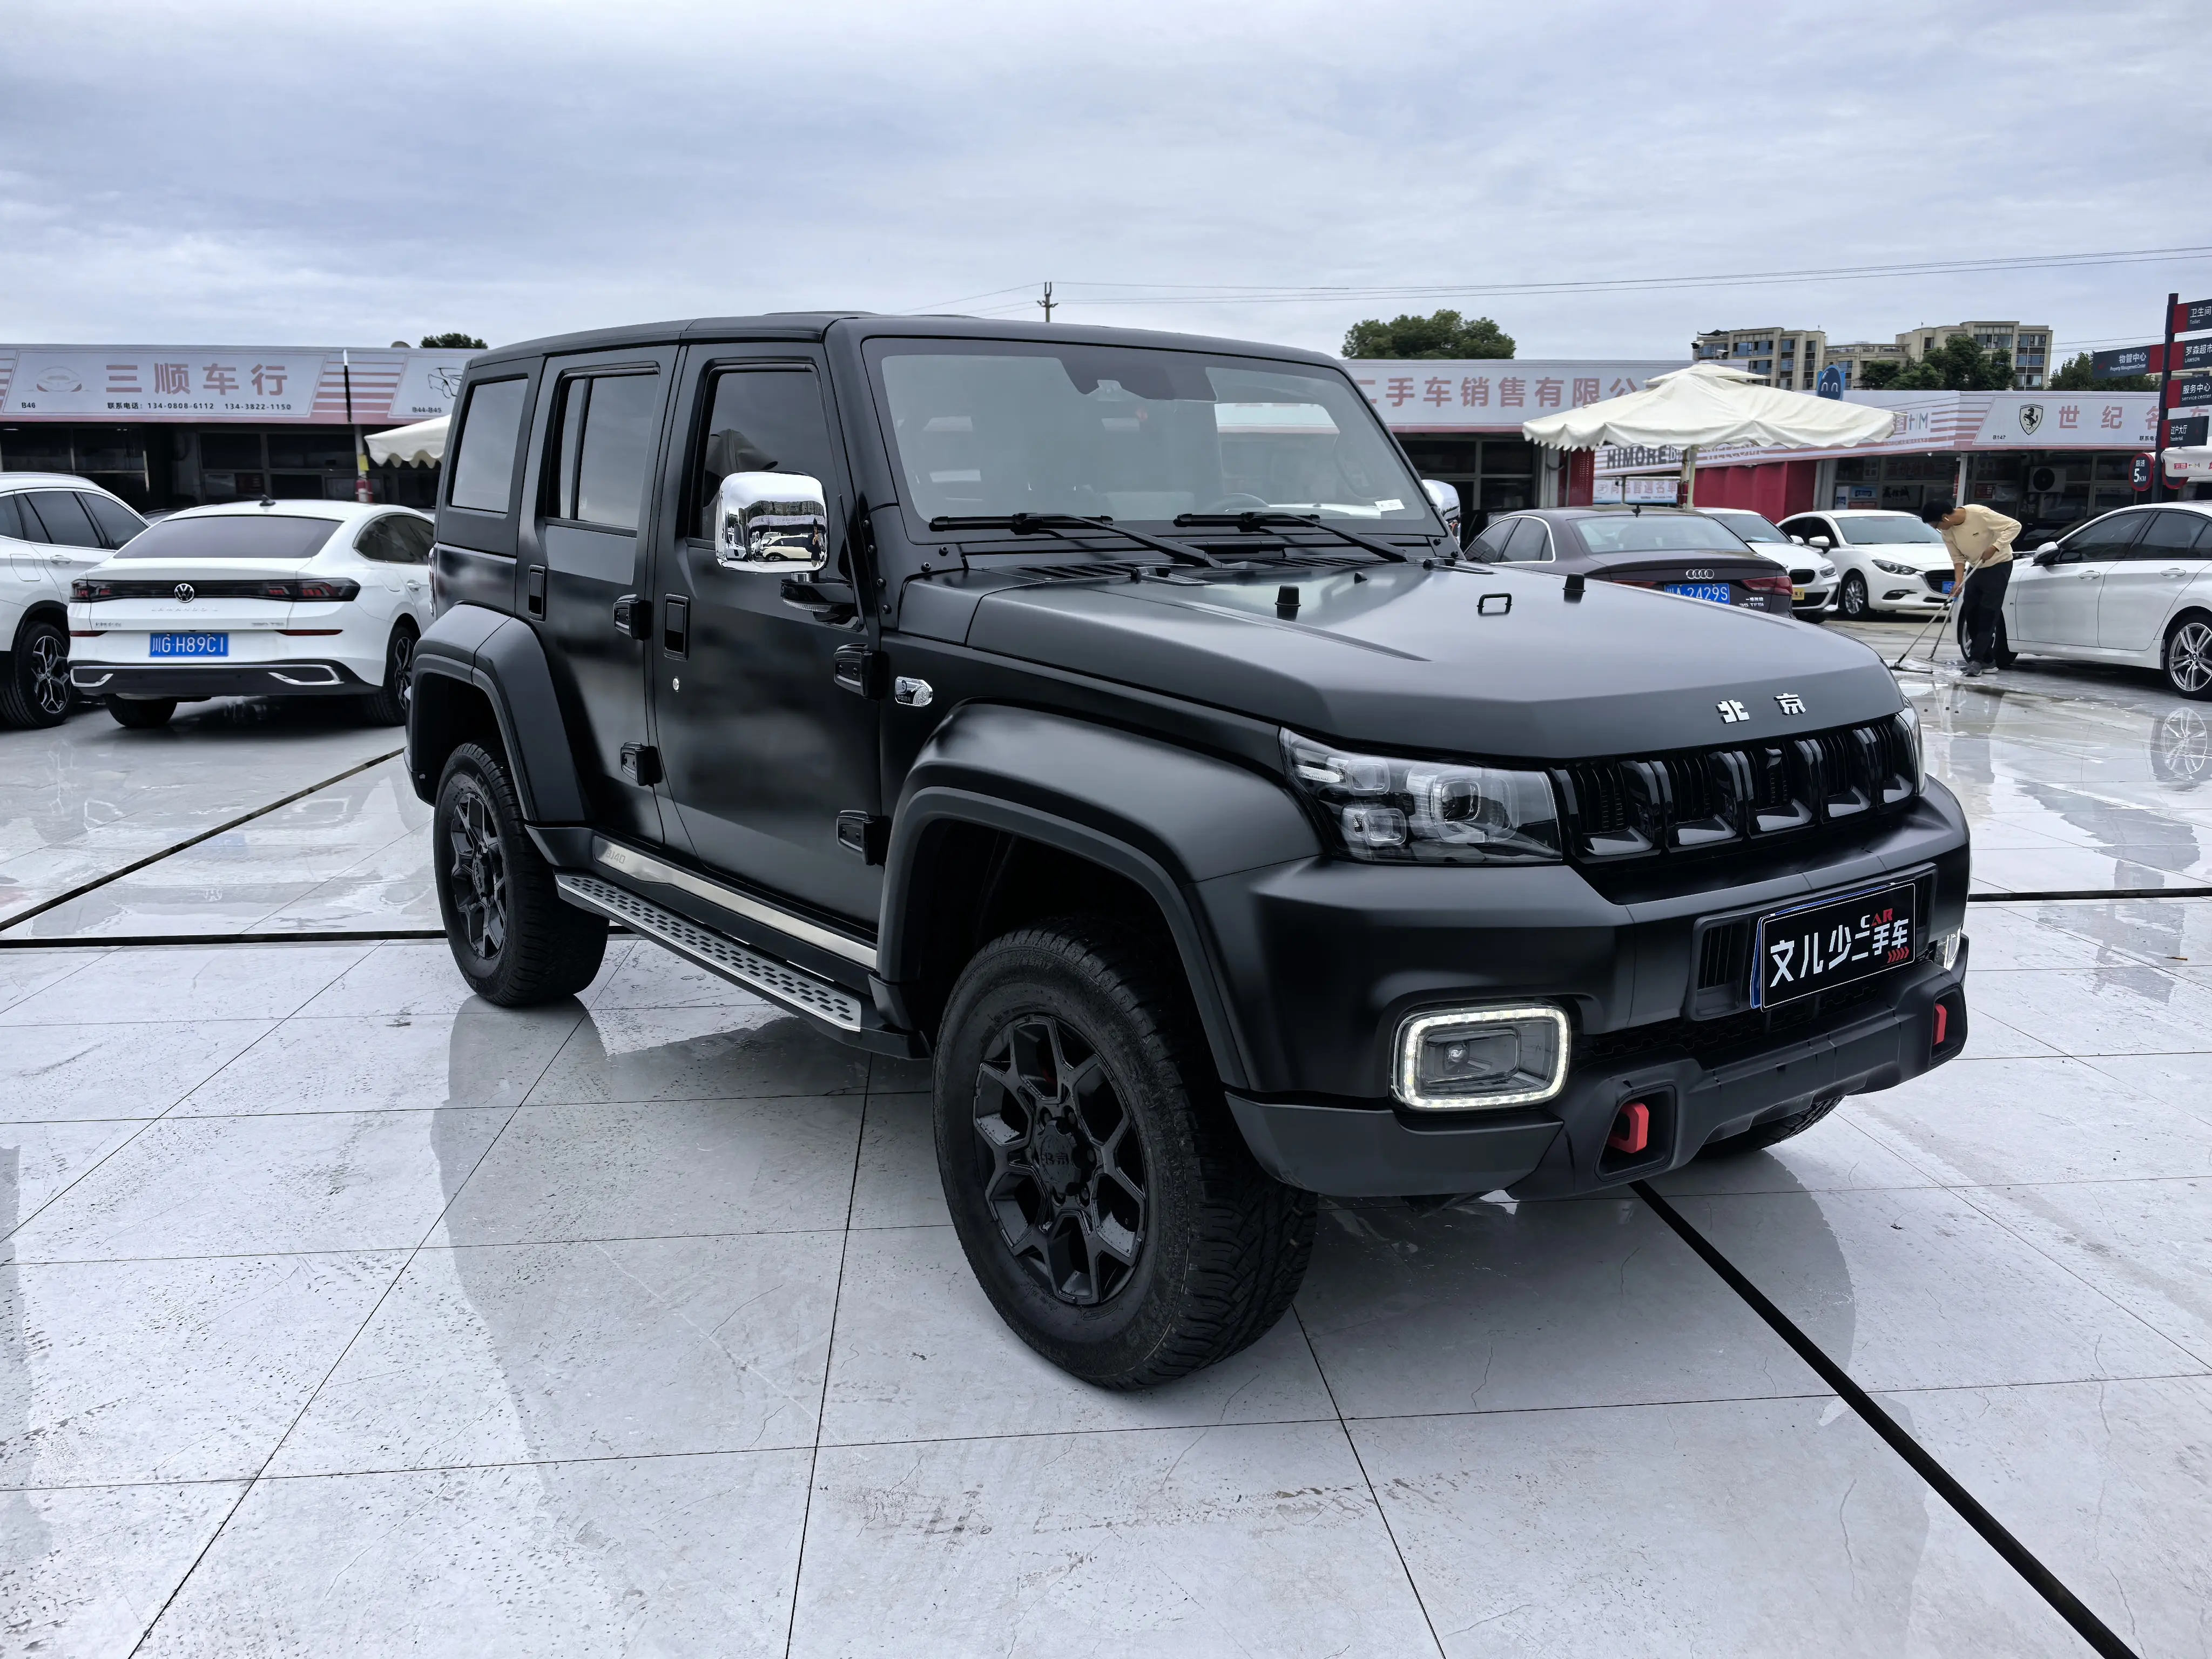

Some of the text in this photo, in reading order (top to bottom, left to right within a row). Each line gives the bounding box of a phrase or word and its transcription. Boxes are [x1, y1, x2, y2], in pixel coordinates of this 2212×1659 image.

[2190, 306, 2211, 318] 卫生间
[2119, 352, 2147, 363] 物管中心
[106, 363, 287, 395] 三顺车行
[2182, 383, 2210, 395] 服务中心
[1716, 693, 1806, 724] 北京
[1860, 908, 1893, 928] CAR
